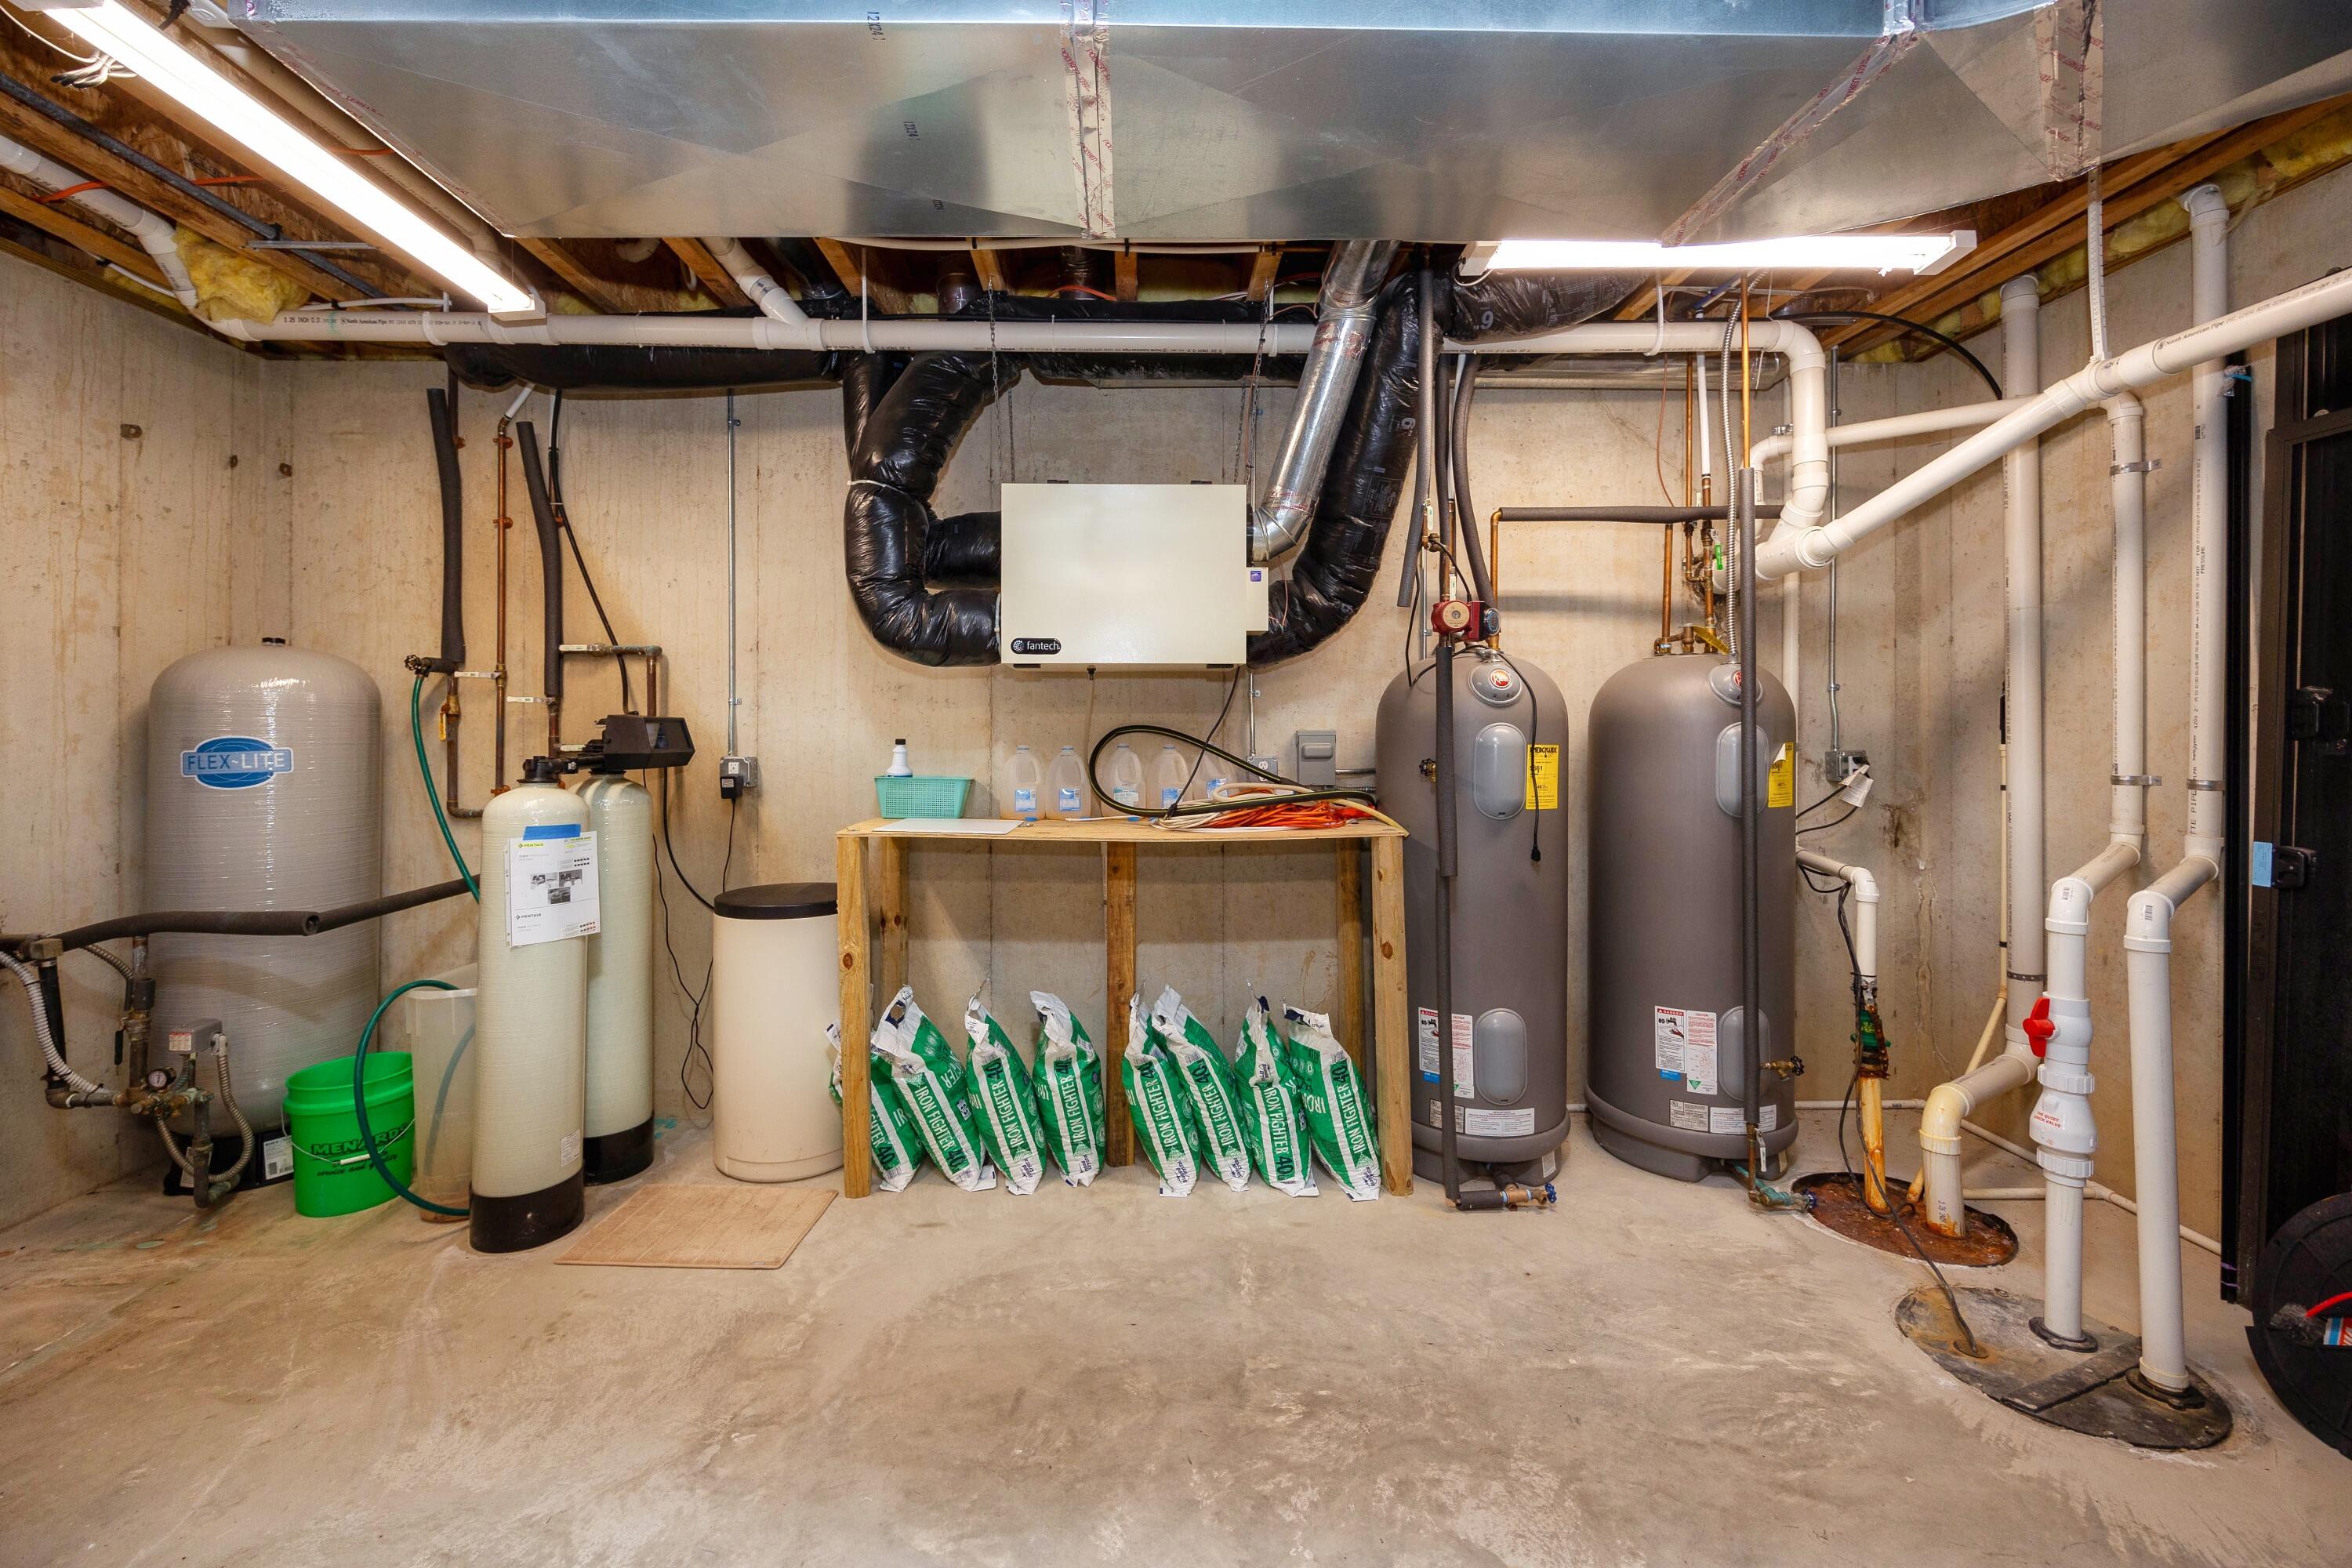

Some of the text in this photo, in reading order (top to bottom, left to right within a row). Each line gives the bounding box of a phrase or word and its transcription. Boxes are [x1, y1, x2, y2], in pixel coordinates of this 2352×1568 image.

[2165, 336, 2182, 347] North
[2183, 325, 2210, 339] American
[2210, 320, 2225, 331] Pipe
[1027, 641, 1059, 650] fantech
[993, 1079, 1016, 1127] FIGHTER
[1060, 1074, 1080, 1119] FIGHTER
[1145, 1078, 1170, 1120] FIGHTER
[1192, 1064, 1235, 1147] IRON FIGHTER 40
[1334, 1064, 1367, 1154] IRON FIGHTER 40
[871, 1113, 886, 1149] GHTER
[915, 1086, 938, 1118] IRON
[927, 1110, 956, 1152] FIGHTER
[1007, 1123, 1025, 1149] IRON
[1069, 1117, 1087, 1143] IRON
[1159, 1118, 1179, 1148] IRON
[1263, 1087, 1294, 1177] IRON FIGHTER 40
[2045, 1120, 2061, 1128] VALVE
